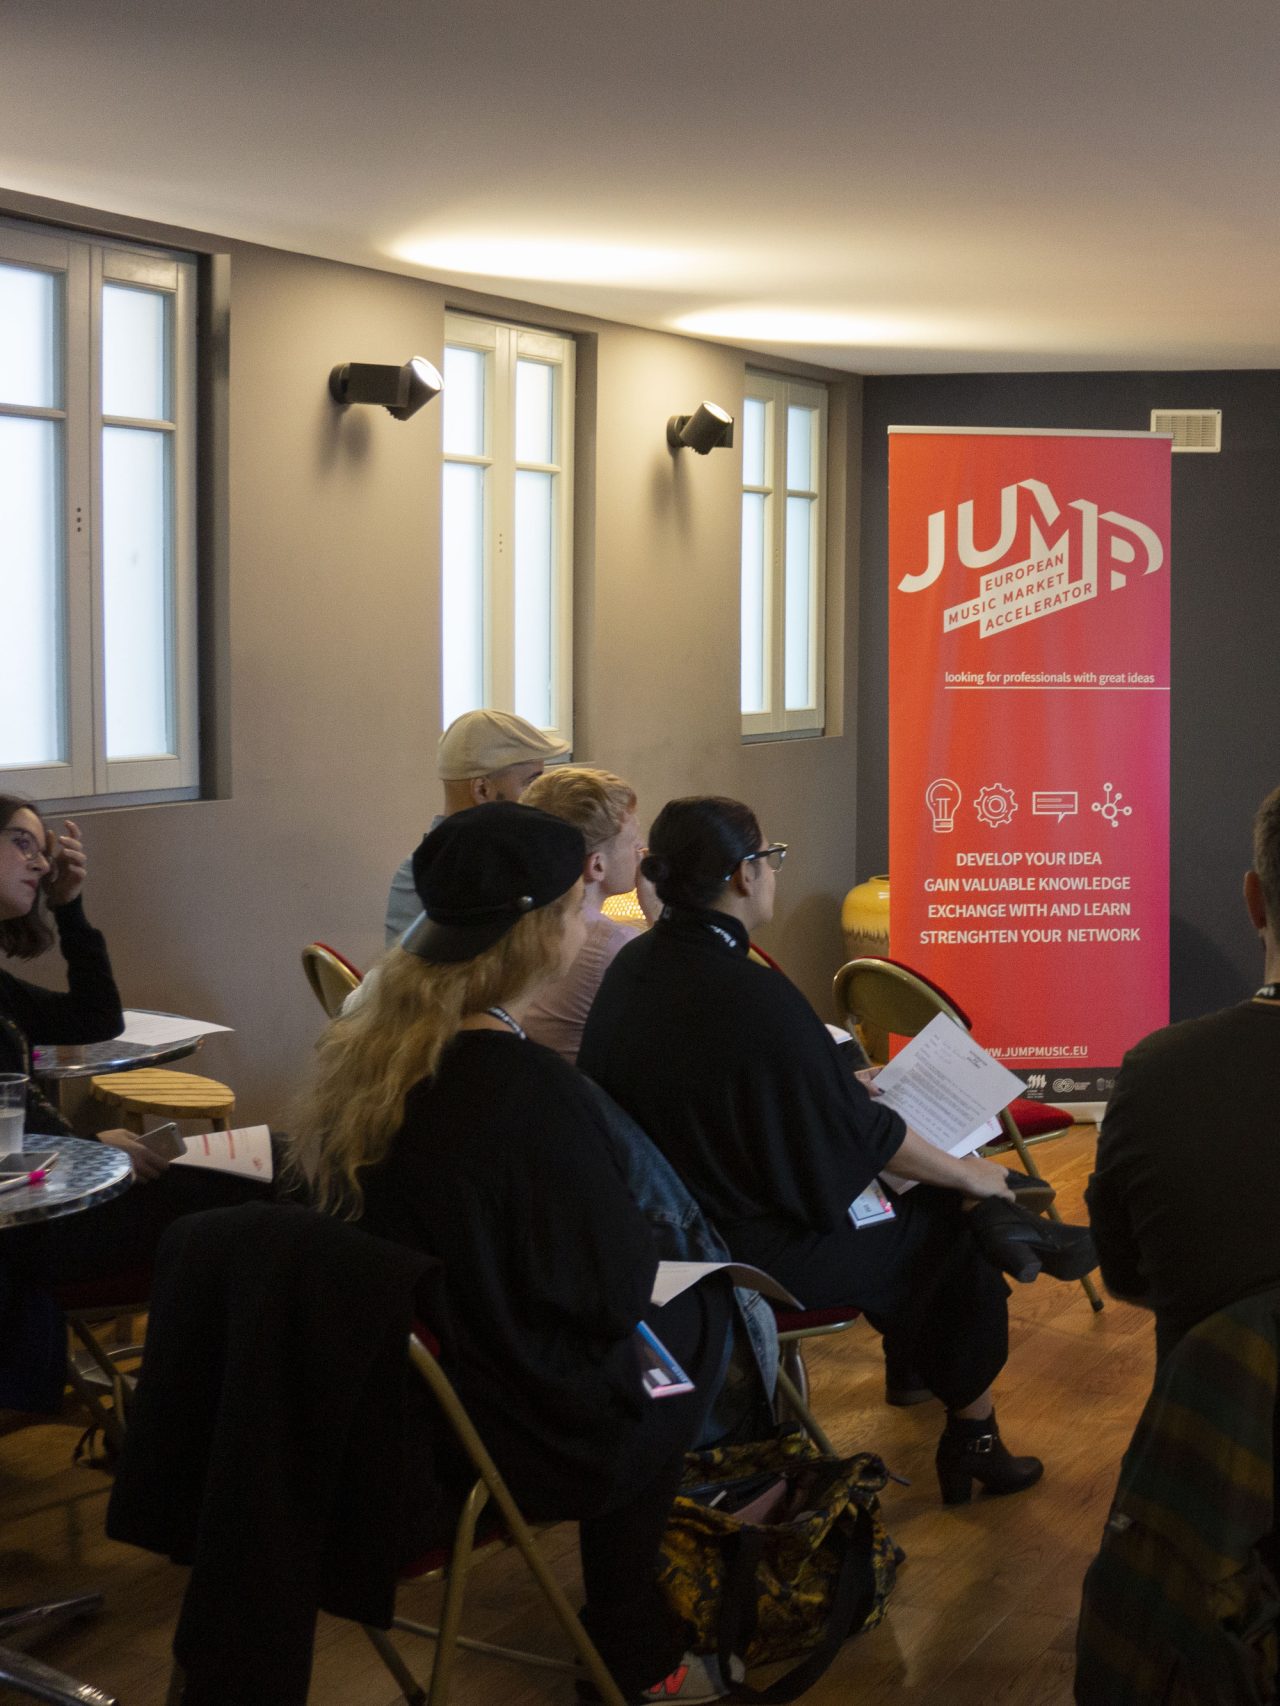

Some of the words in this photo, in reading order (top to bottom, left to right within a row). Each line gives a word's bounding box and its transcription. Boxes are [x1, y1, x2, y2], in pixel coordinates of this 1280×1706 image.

[897, 478, 1164, 593] JUMP
[985, 553, 1064, 592] EUROPEAN
[948, 597, 997, 625] MUSIC
[1003, 572, 1065, 605] MARKET
[985, 582, 1093, 632] ACCELERATOR
[945, 672, 984, 685] looking
[986, 672, 1001, 682] for
[1003, 672, 1071, 684] professionals
[1073, 672, 1097, 682] with
[1099, 673, 1126, 685] great
[1127, 672, 1155, 683] ideas
[956, 852, 1023, 866] DEVELOP
[1025, 852, 1066, 866] YOUR
[1068, 851, 1102, 865] IDEA
[924, 878, 960, 892] GAIN
[961, 877, 1036, 891] VALUABLE
[1039, 876, 1131, 891] KNOWLEDGE
[928, 904, 1007, 918] EXCHANGE
[1009, 903, 1048, 917] WITH
[1050, 903, 1081, 917] AND
[1084, 902, 1131, 916] LEARN
[920, 930, 1018, 944] STRENGHTEN
[1020, 929, 1062, 943] YOUR
[1067, 928, 1141, 942] NETWORK
